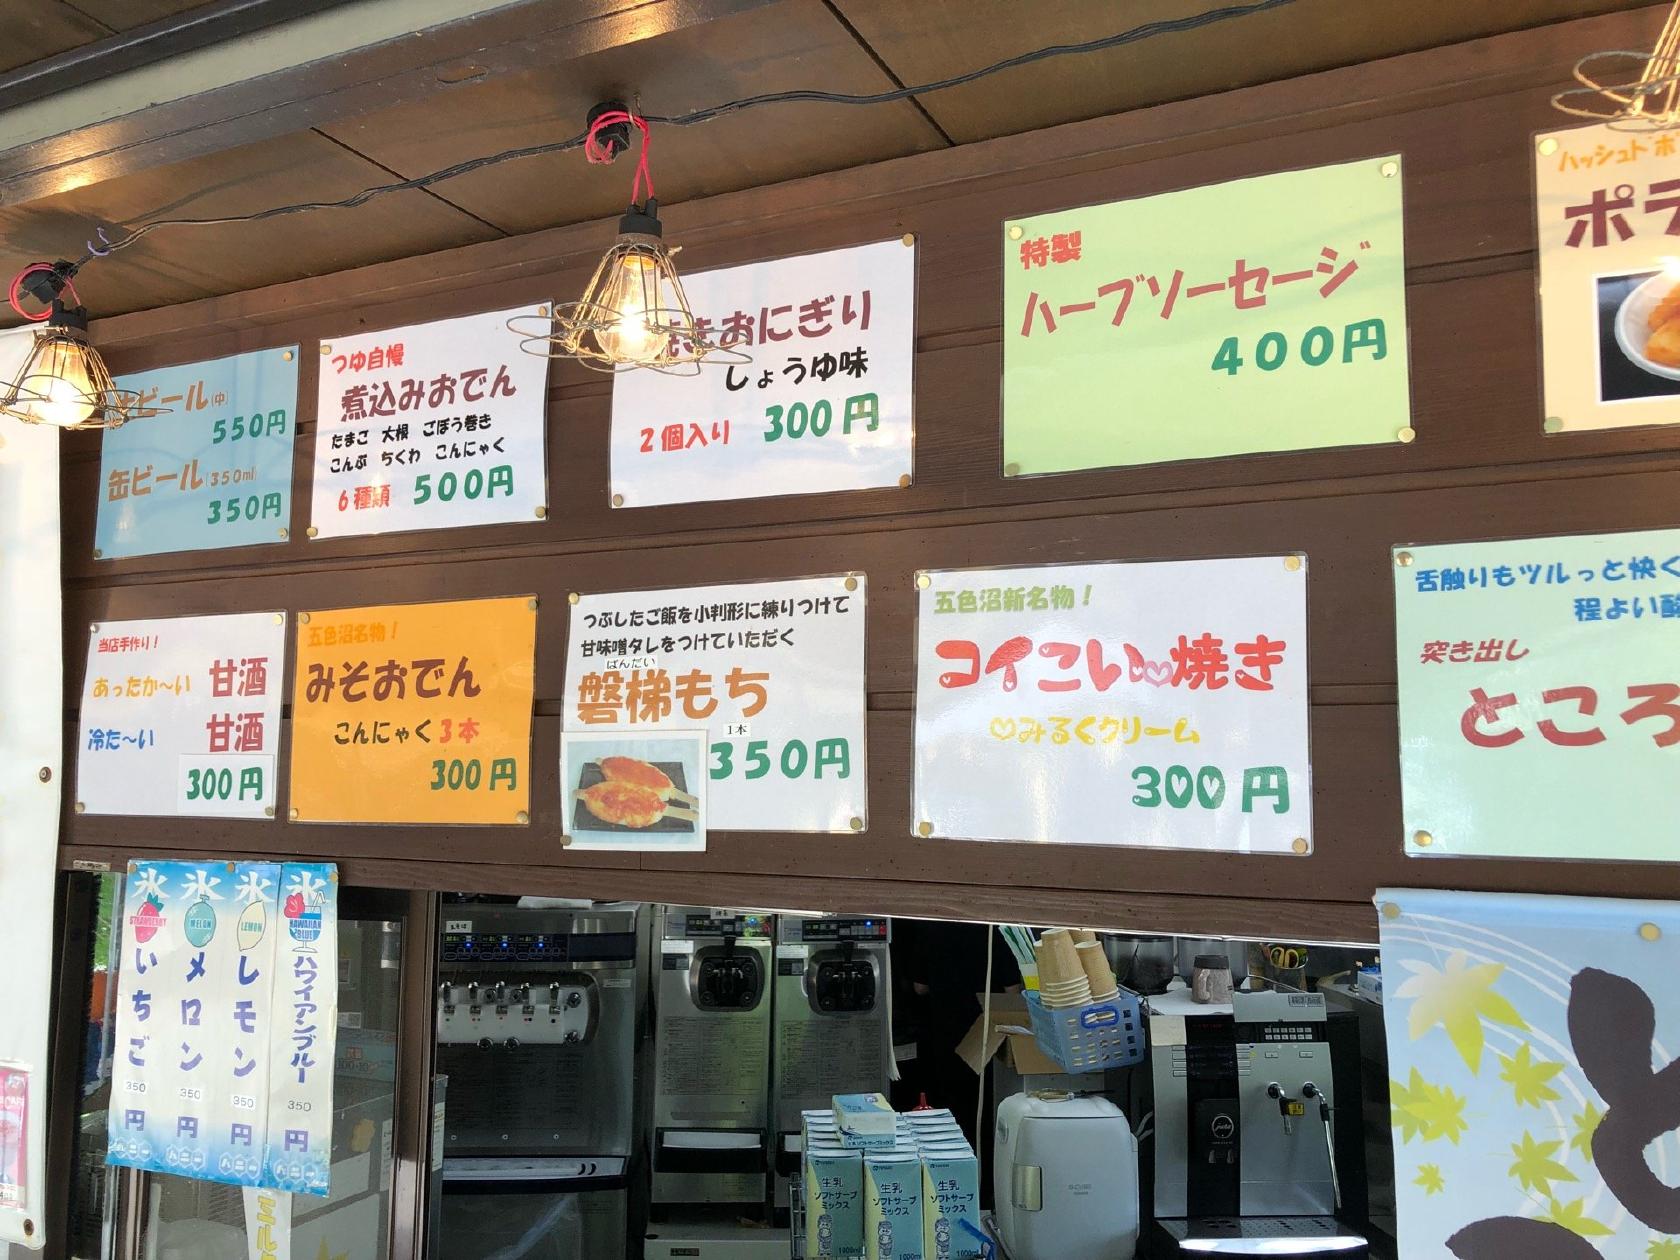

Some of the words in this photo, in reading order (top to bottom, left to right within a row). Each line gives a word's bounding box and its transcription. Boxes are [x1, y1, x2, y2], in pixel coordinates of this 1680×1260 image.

[1020, 230, 1081, 270] 特製
[1021, 240, 1371, 337] ハーブソーセージ
[331, 343, 404, 374] つゆ自慢
[1211, 318, 1388, 376] 400円
[725, 346, 869, 391] しょうゆ味
[340, 365, 517, 423] 煮込みおでん
[213, 409, 286, 444] 550円
[764, 393, 879, 441] 300円
[640, 420, 730, 452] 2個入り
[413, 464, 514, 506] 500円
[207, 492, 281, 525] 350円
[583, 595, 850, 629] つぶしたご飯を小判形に練りつけて
[933, 585, 1093, 614] 五色沼新名物！
[308, 621, 398, 648] 五色沼名物！
[581, 628, 795, 658] 甘味噌タレをつけていただく
[1420, 638, 1530, 664] 突き出し
[209, 656, 268, 698] 甘酒
[305, 656, 482, 703] みそおでん
[606, 657, 657, 670] ばんだい
[577, 666, 770, 725] 磐梯もち
[206, 712, 265, 753] 甘酒
[727, 724, 748, 735] 1本
[430, 757, 517, 792] 300円
[709, 737, 851, 780] 350円
[186, 766, 263, 801] 300円
[1131, 765, 1290, 814] 300円
[131, 867, 171, 900] 氷
[180, 870, 225, 900] 氷
[234, 871, 275, 904] 氷
[128, 948, 157, 1067] いちご
[180, 951, 205, 1072] メロン
[233, 955, 260, 1078] レモン
[290, 956, 318, 1083] ハワイアンブルー
[822, 1177, 844, 1187] 生乳
[880, 1183, 902, 1194] 生乳
[938, 1180, 959, 1190] 生乳
[822, 1201, 850, 1209] ミックス
[880, 1207, 909, 1215] ミックス
[938, 1204, 967, 1213] ミックス
